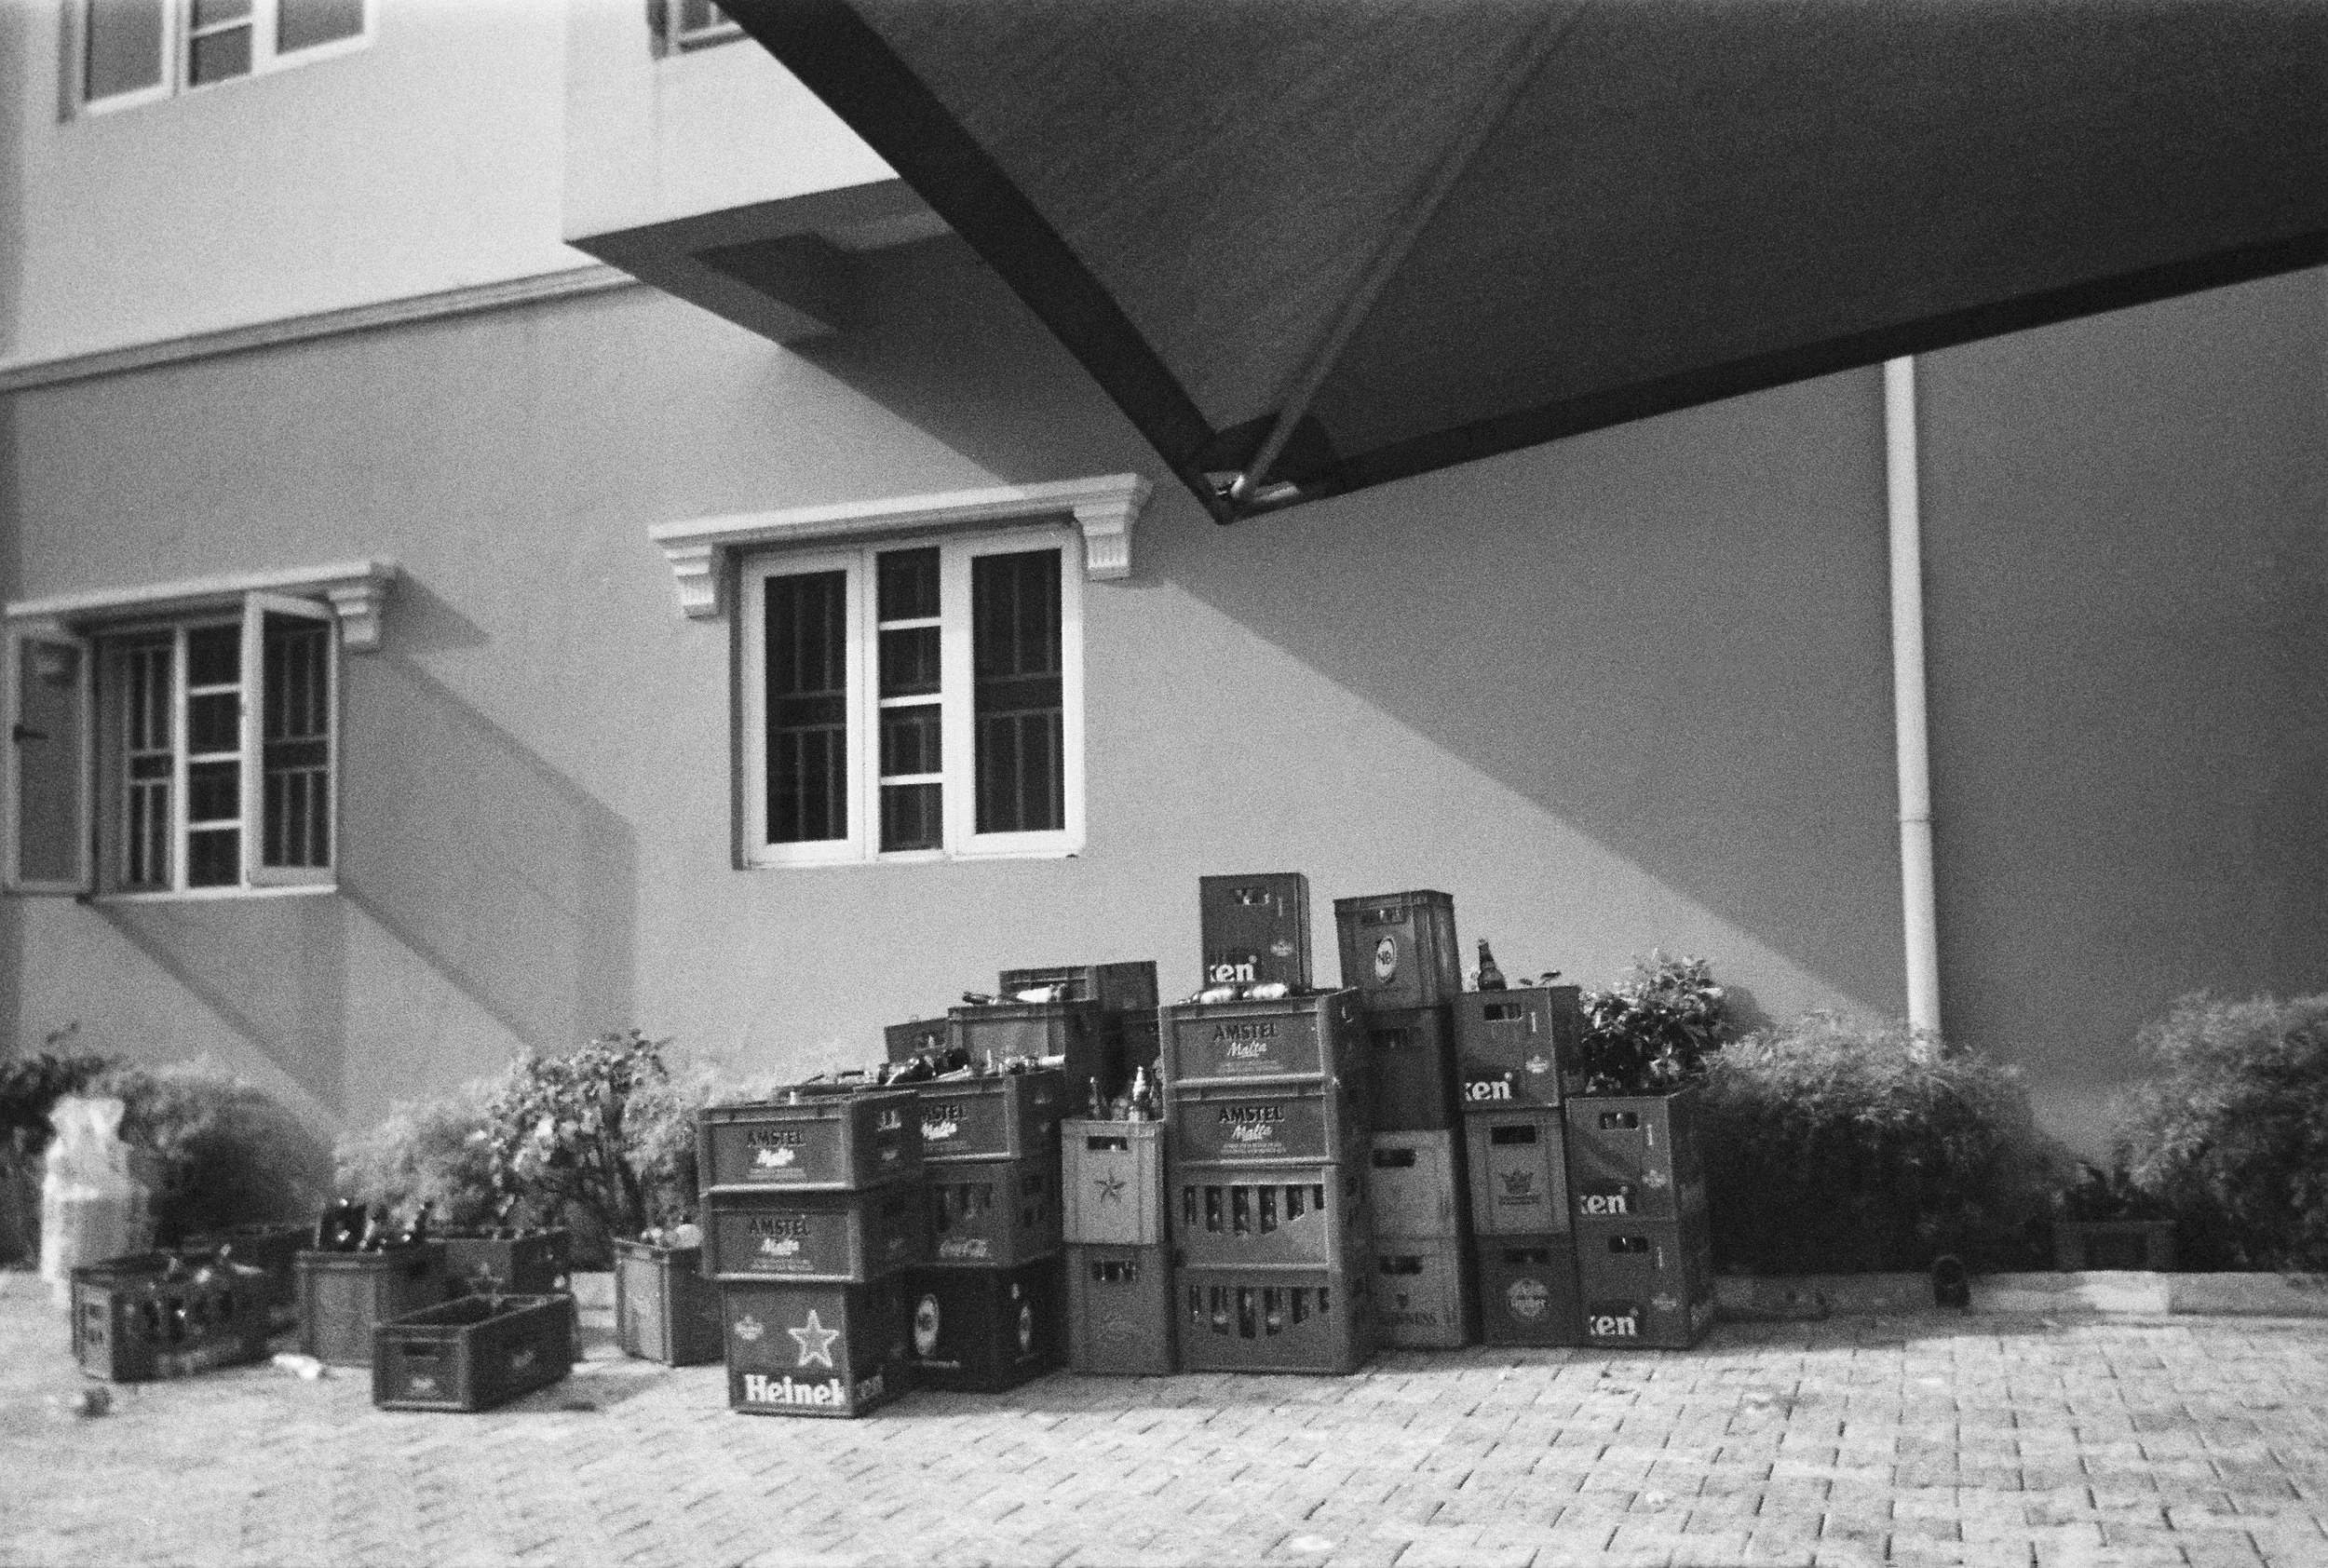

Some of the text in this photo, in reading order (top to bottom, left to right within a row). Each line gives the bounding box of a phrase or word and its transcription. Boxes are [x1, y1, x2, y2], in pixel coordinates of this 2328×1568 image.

[1213, 1022, 1279, 1040] AMSTEL
[1226, 1040, 1267, 1059] Malta
[1218, 1104, 1285, 1123] AMSTEL
[748, 1129, 806, 1147] AMSTEL
[1232, 1122, 1273, 1142] Malta
[748, 1219, 810, 1237] AMSTEL
